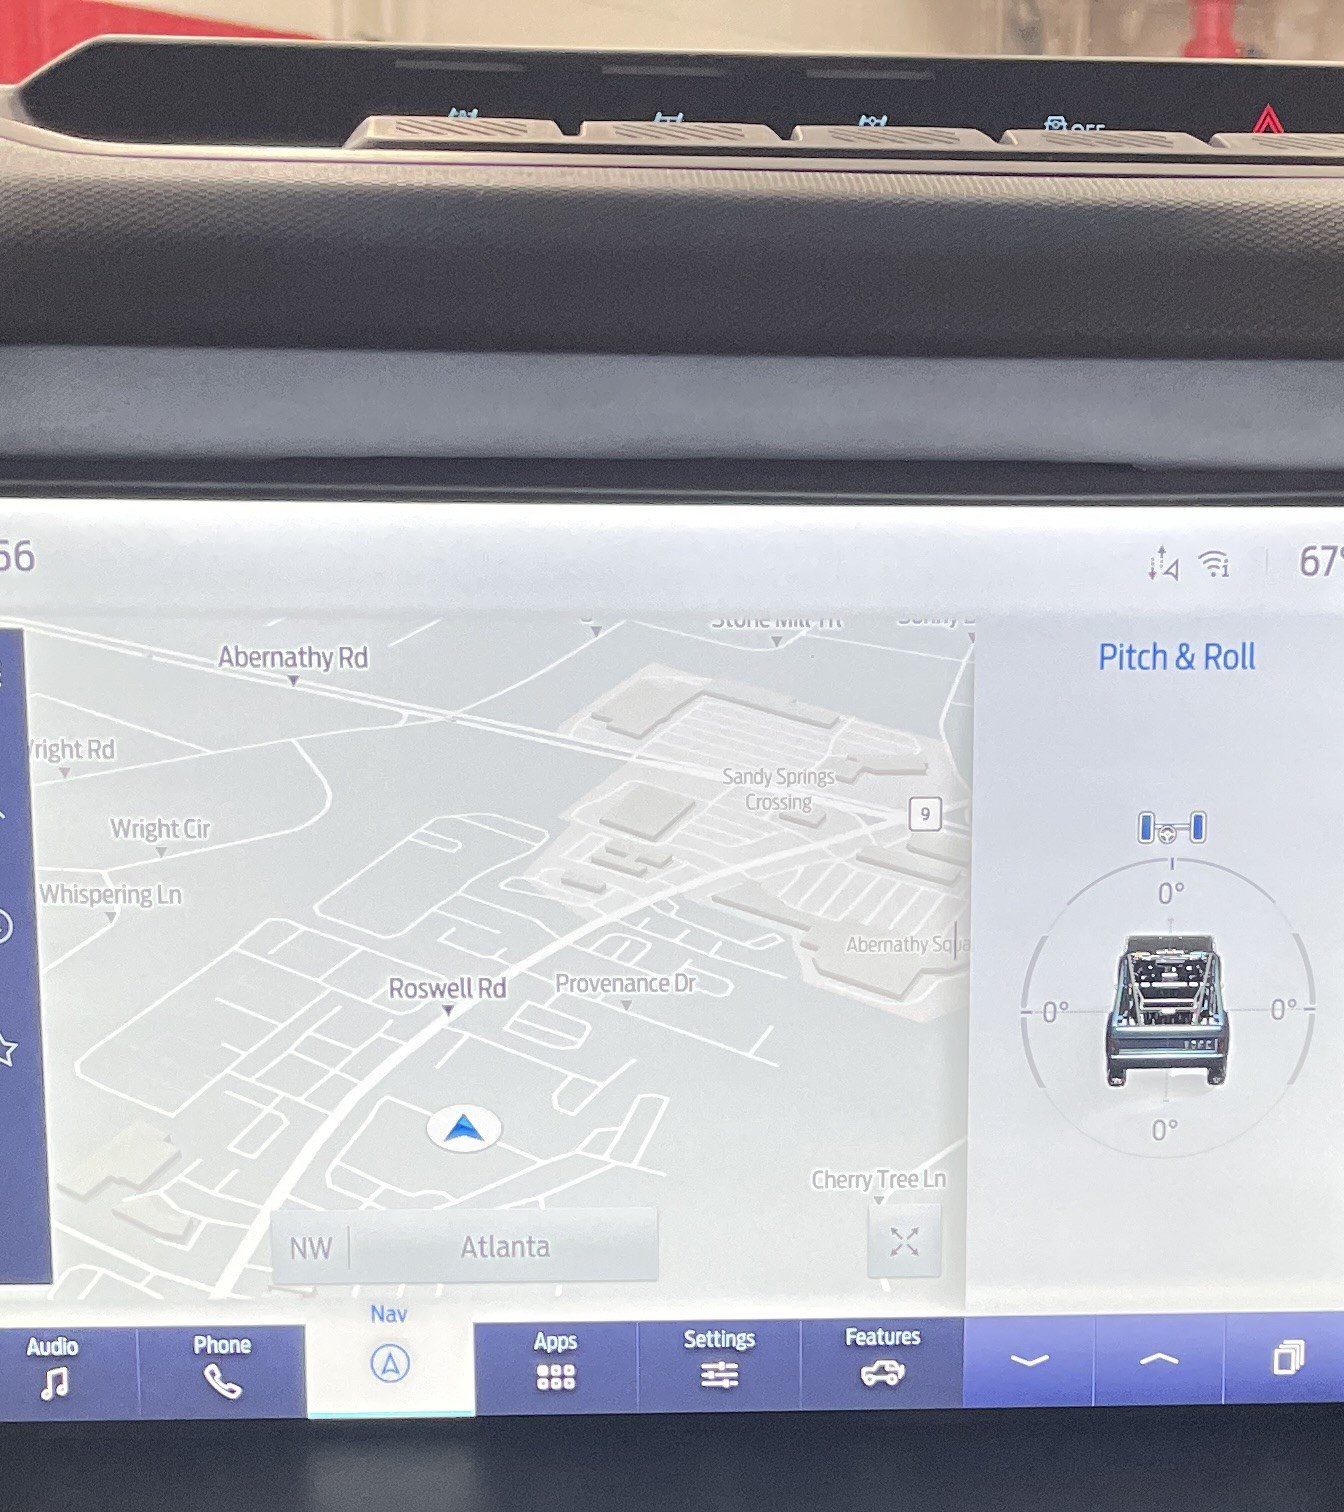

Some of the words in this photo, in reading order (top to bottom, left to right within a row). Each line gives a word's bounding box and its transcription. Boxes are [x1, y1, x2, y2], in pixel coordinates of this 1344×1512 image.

[218, 645, 334, 673] Abernathy
[339, 646, 368, 669] Rd
[1099, 641, 1168, 671] Pitch
[1175, 642, 1195, 671] &
[1204, 641, 1256, 670] Roll
[31, 738, 83, 763] right
[87, 738, 115, 760] Rd
[722, 767, 773, 788] Sandy
[776, 767, 836, 788] Springs
[745, 792, 813, 813] Crossing
[920, 806, 931, 821] 9
[110, 818, 180, 843] Wright
[183, 818, 211, 839] Cir
[39, 883, 153, 909] Whispering
[157, 884, 182, 904] Ln
[847, 935, 929, 955] Abernathy
[389, 977, 473, 999] Roswell
[478, 977, 507, 999] Rd
[556, 973, 662, 993] Provenance
[668, 972, 696, 993] Dr
[812, 1169, 873, 1192] Cherry
[876, 1169, 919, 1189] Tree
[925, 1168, 947, 1189] Ln
[290, 1236, 333, 1260] NW
[460, 1234, 551, 1259] Atlanta
[371, 1304, 407, 1323] Nav
[26, 1336, 79, 1356] Audio
[194, 1335, 252, 1354] Phone
[533, 1331, 578, 1353] Apps
[684, 1329, 756, 1351] Settings
[846, 1327, 921, 1346] Features
